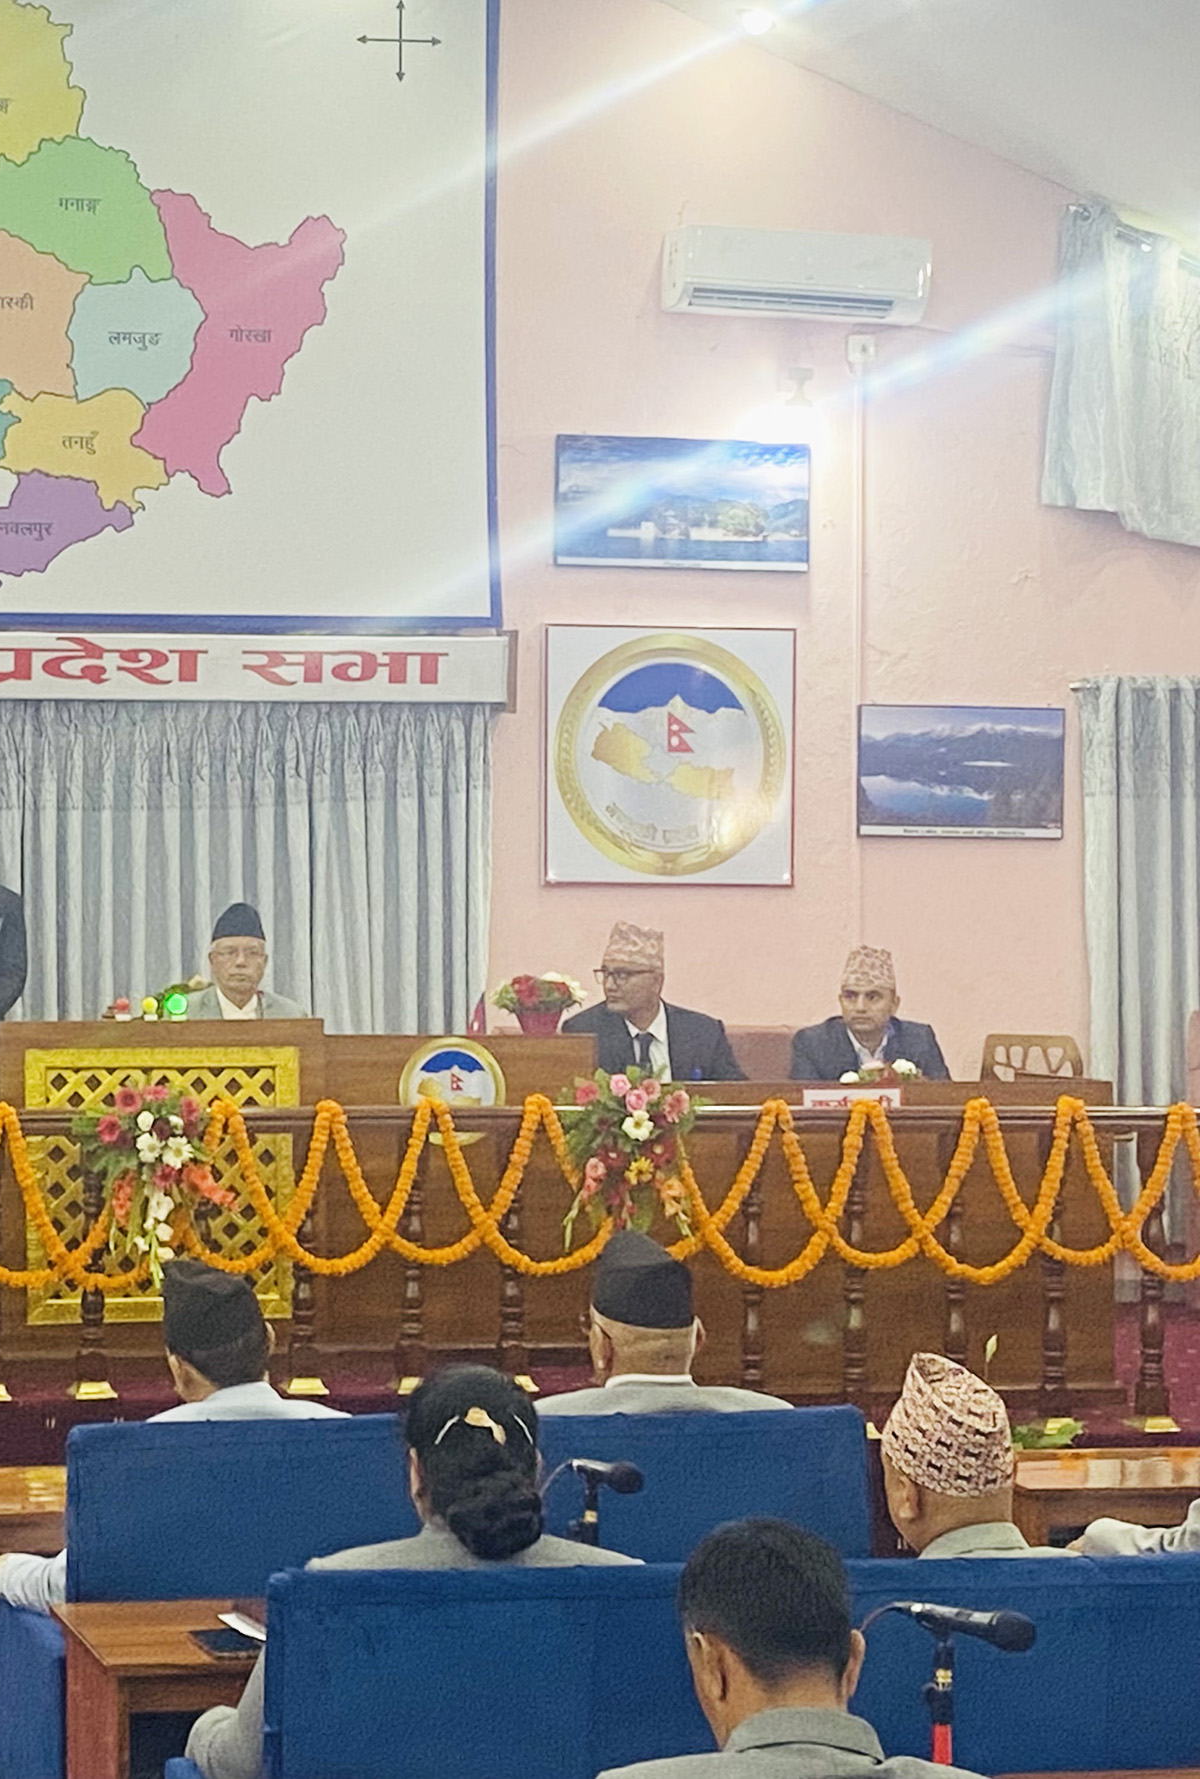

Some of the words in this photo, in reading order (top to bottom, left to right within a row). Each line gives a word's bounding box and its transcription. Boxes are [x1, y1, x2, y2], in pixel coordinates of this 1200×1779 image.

[107, 331, 163, 351] लमजुङ
[228, 324, 272, 343] गोरखा
[242, 649, 449, 686] सभा
